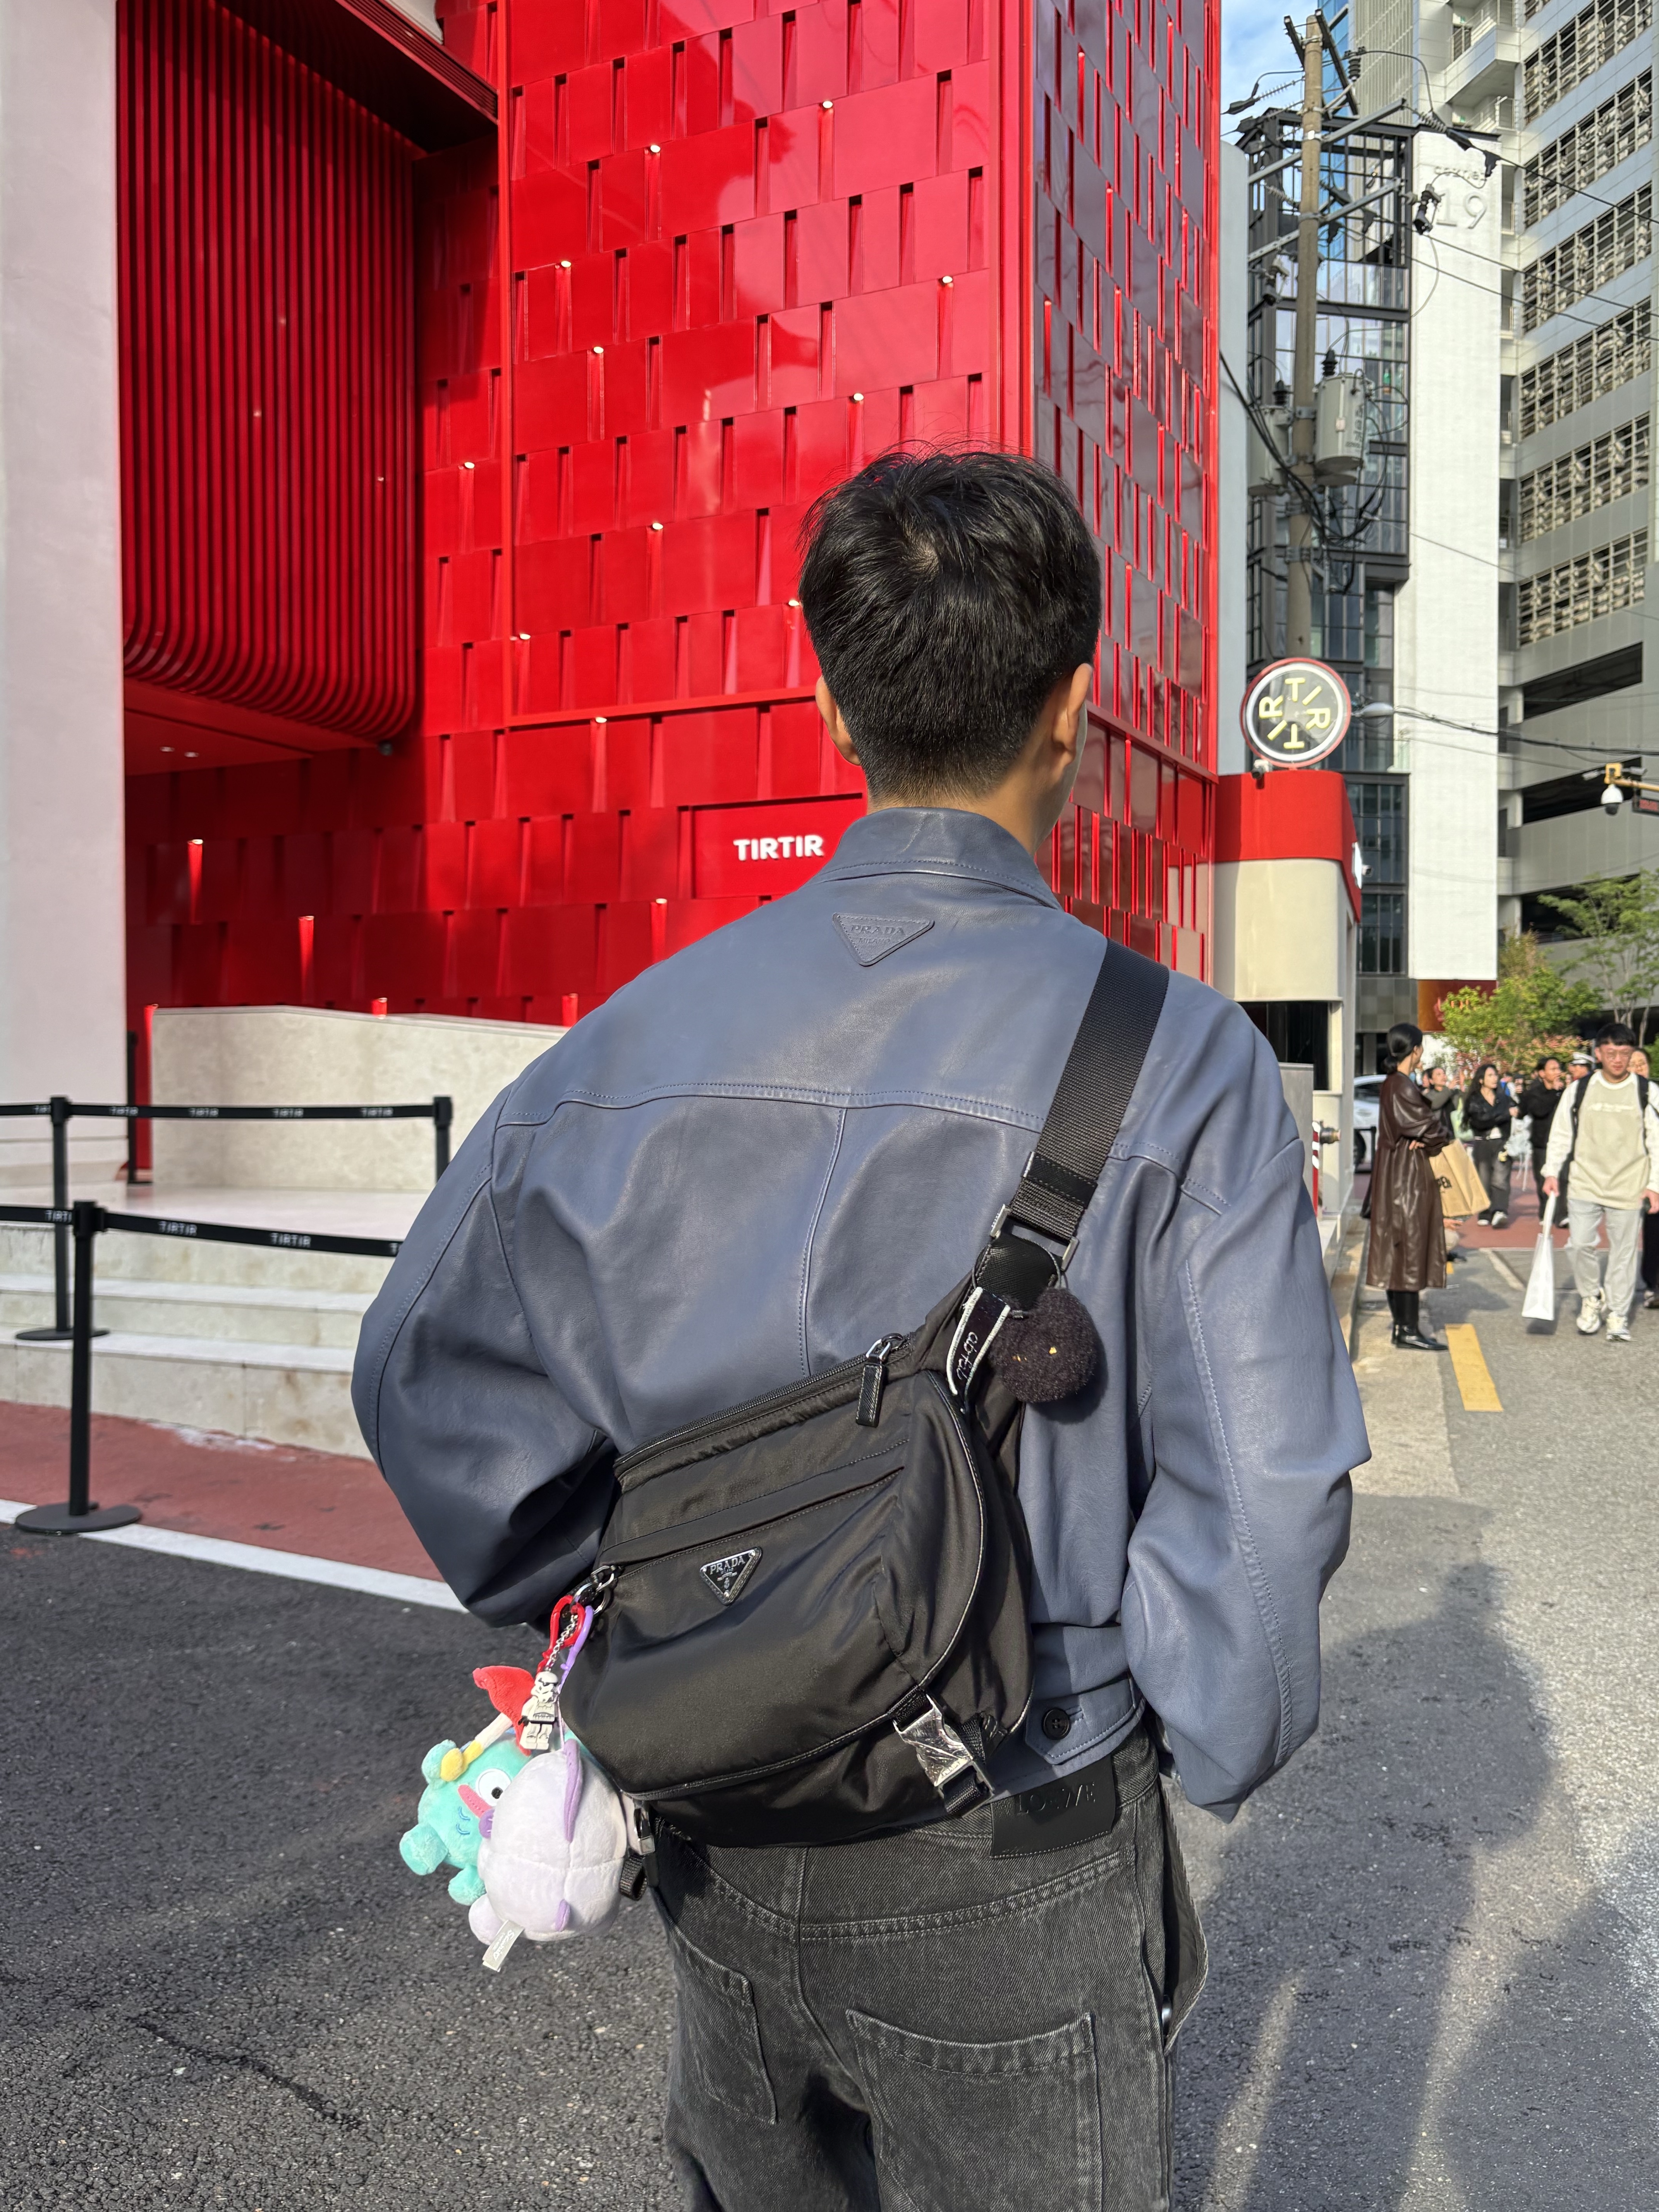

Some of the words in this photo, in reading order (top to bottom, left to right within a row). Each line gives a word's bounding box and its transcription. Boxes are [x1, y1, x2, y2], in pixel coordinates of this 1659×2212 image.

[733, 835, 824, 861] TIRTIR
[851, 924, 905, 936] PRADA
[45, 1211, 72, 1222] TIRTI
[158, 1221, 197, 1236] TIRTIR
[270, 1232, 311, 1248] TIRTIR
[709, 1556, 745, 1575] PRADA
